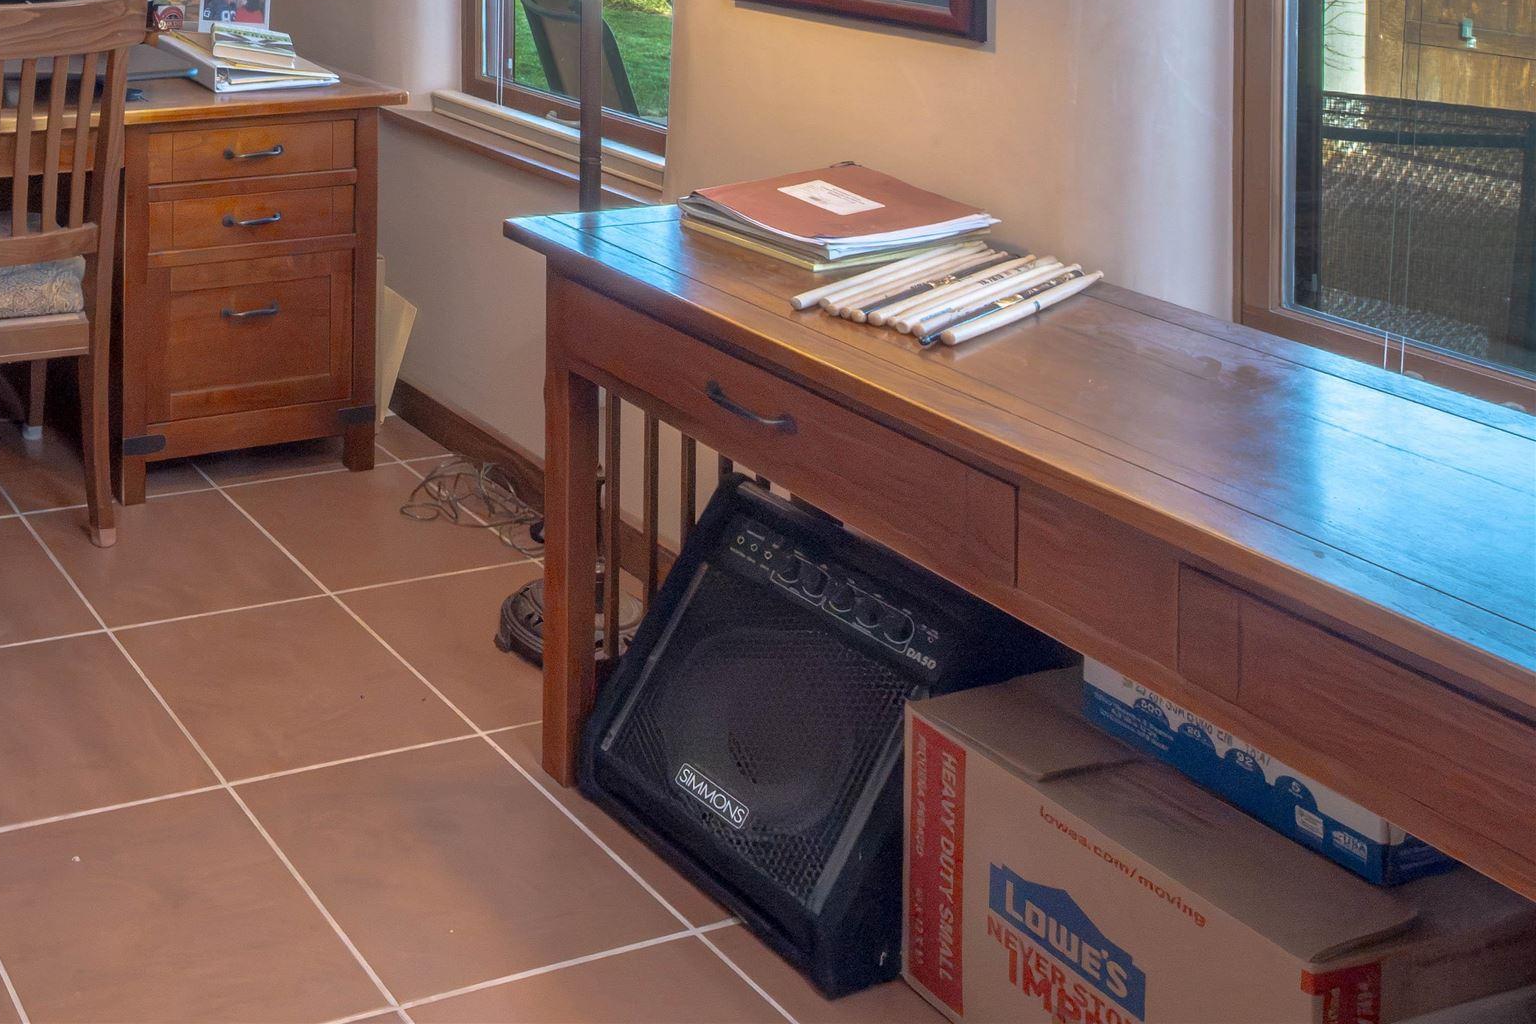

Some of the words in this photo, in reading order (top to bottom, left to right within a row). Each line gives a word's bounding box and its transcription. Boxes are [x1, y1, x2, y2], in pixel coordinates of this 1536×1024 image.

[678, 768, 747, 825] SIMMONS
[941, 751, 958, 833] HEAVY
[939, 835, 955, 902] DUTY
[939, 904, 954, 982] SMALL
[987, 915, 1066, 987] NEVER
[1072, 983, 1133, 1024] STO
[1005, 880, 1129, 998] LOWE'S
